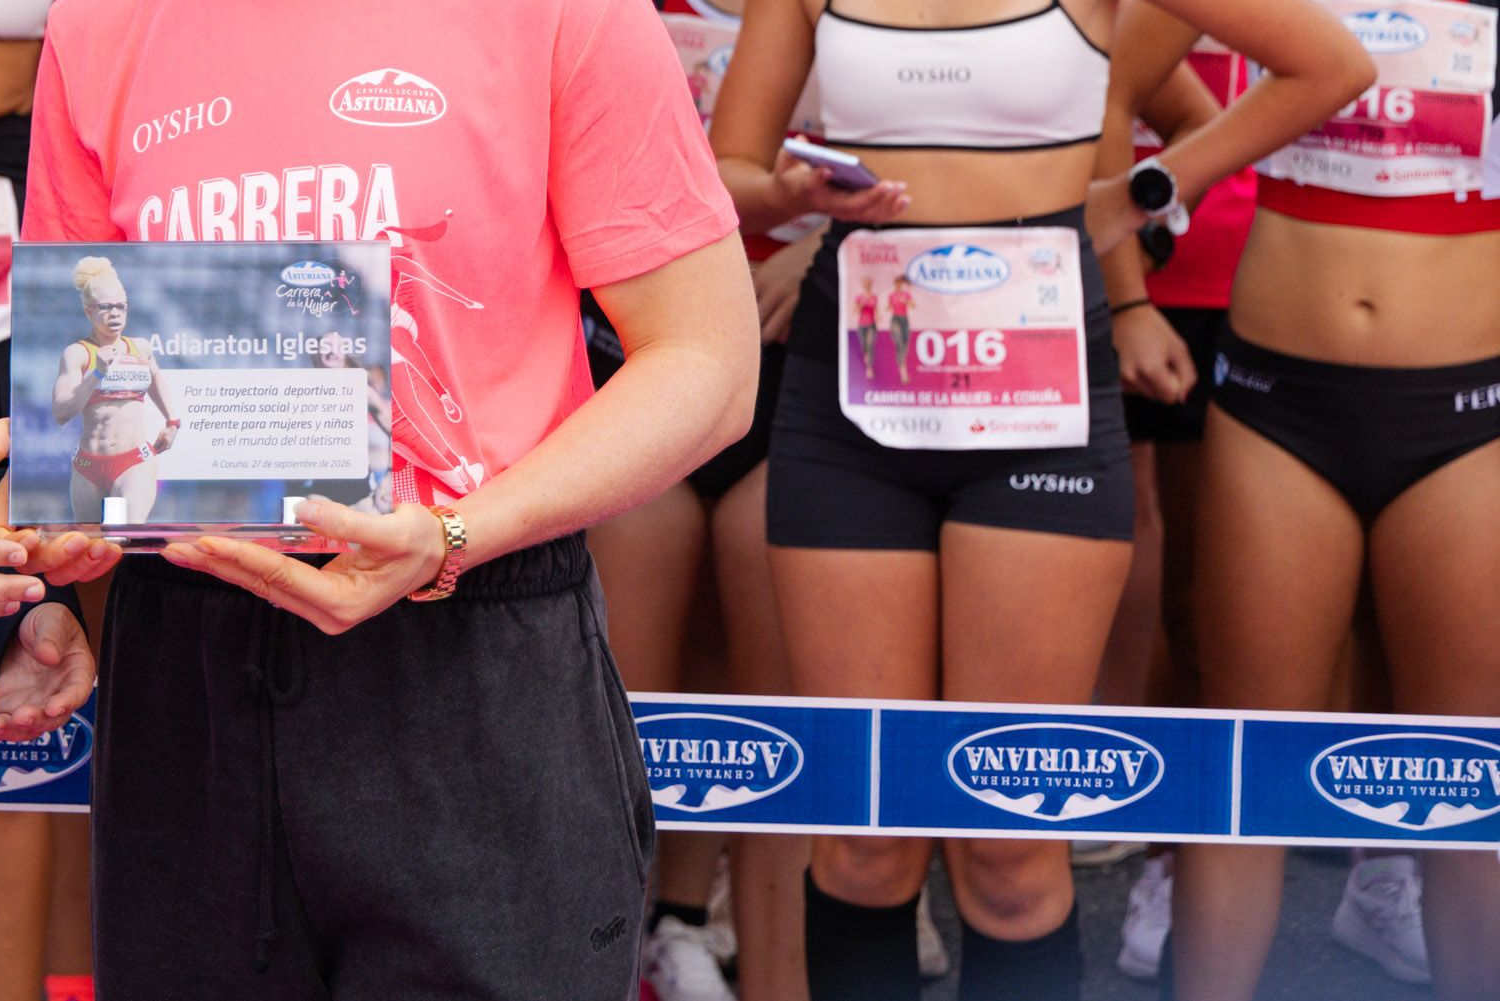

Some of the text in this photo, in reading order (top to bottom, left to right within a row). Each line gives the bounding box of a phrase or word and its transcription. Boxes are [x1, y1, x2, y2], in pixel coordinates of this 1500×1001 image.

[898, 65, 971, 84] OYSHO
[356, 88, 436, 98] CENTRAL LECHERA
[338, 89, 438, 117] ASTURIANA
[132, 97, 232, 153] OYSHO
[138, 163, 404, 247] CARRERA
[276, 284, 321, 299] Carrera
[301, 298, 338, 318] Mujer
[149, 331, 367, 360] Adiaratou Iglesias
[915, 329, 1007, 367] 016
[184, 384, 353, 401] Por tu trayectoria deportiva, tu
[188, 402, 353, 417] compromiso social y por ser un
[189, 417, 238, 432] referente
[241, 419, 266, 433] para
[269, 418, 312, 433] mujeres
[323, 417, 354, 429] niñas
[870, 415, 942, 434] OYSHO
[211, 434, 353, 447] en el mundo del atletismo.
[212, 460, 218, 468] A
[252, 459, 262, 468] 27
[263, 459, 272, 468] de
[274, 459, 317, 470] septiembre
[319, 459, 329, 468] de
[1009, 474, 1095, 495] OYSHO
[640, 738, 788, 779] ASTURIA
[964, 746, 1149, 788] ASTURIANA
[687, 768, 754, 780] CENTRAL
[971, 775, 1114, 788] CENTRAL LECHERA
[1327, 756, 1500, 796] ASTURIANA
[1334, 784, 1480, 797] CENTRAL LECHERA
